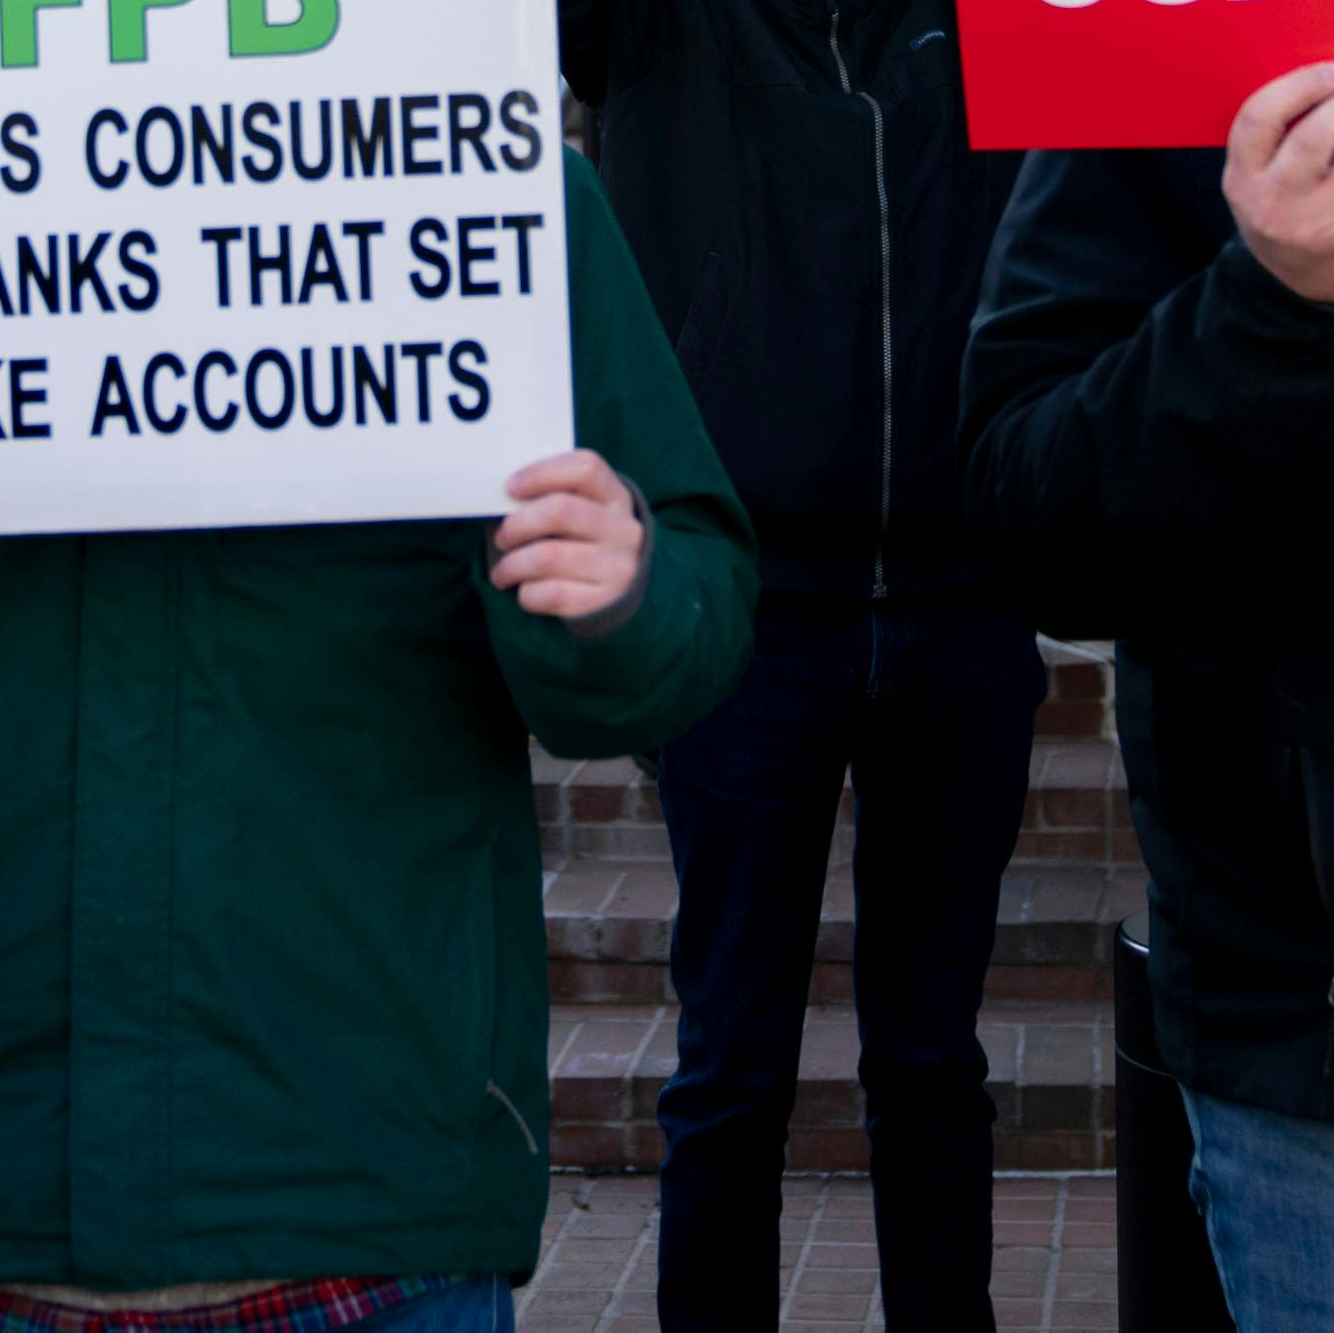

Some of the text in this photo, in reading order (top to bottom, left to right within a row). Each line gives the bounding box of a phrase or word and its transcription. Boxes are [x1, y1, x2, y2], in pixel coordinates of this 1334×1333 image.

[85, 90, 543, 191] CONSUMERS
[200, 220, 385, 308] THAT
[409, 213, 545, 300] SET
[90, 339, 492, 437] ACCOUNTS
